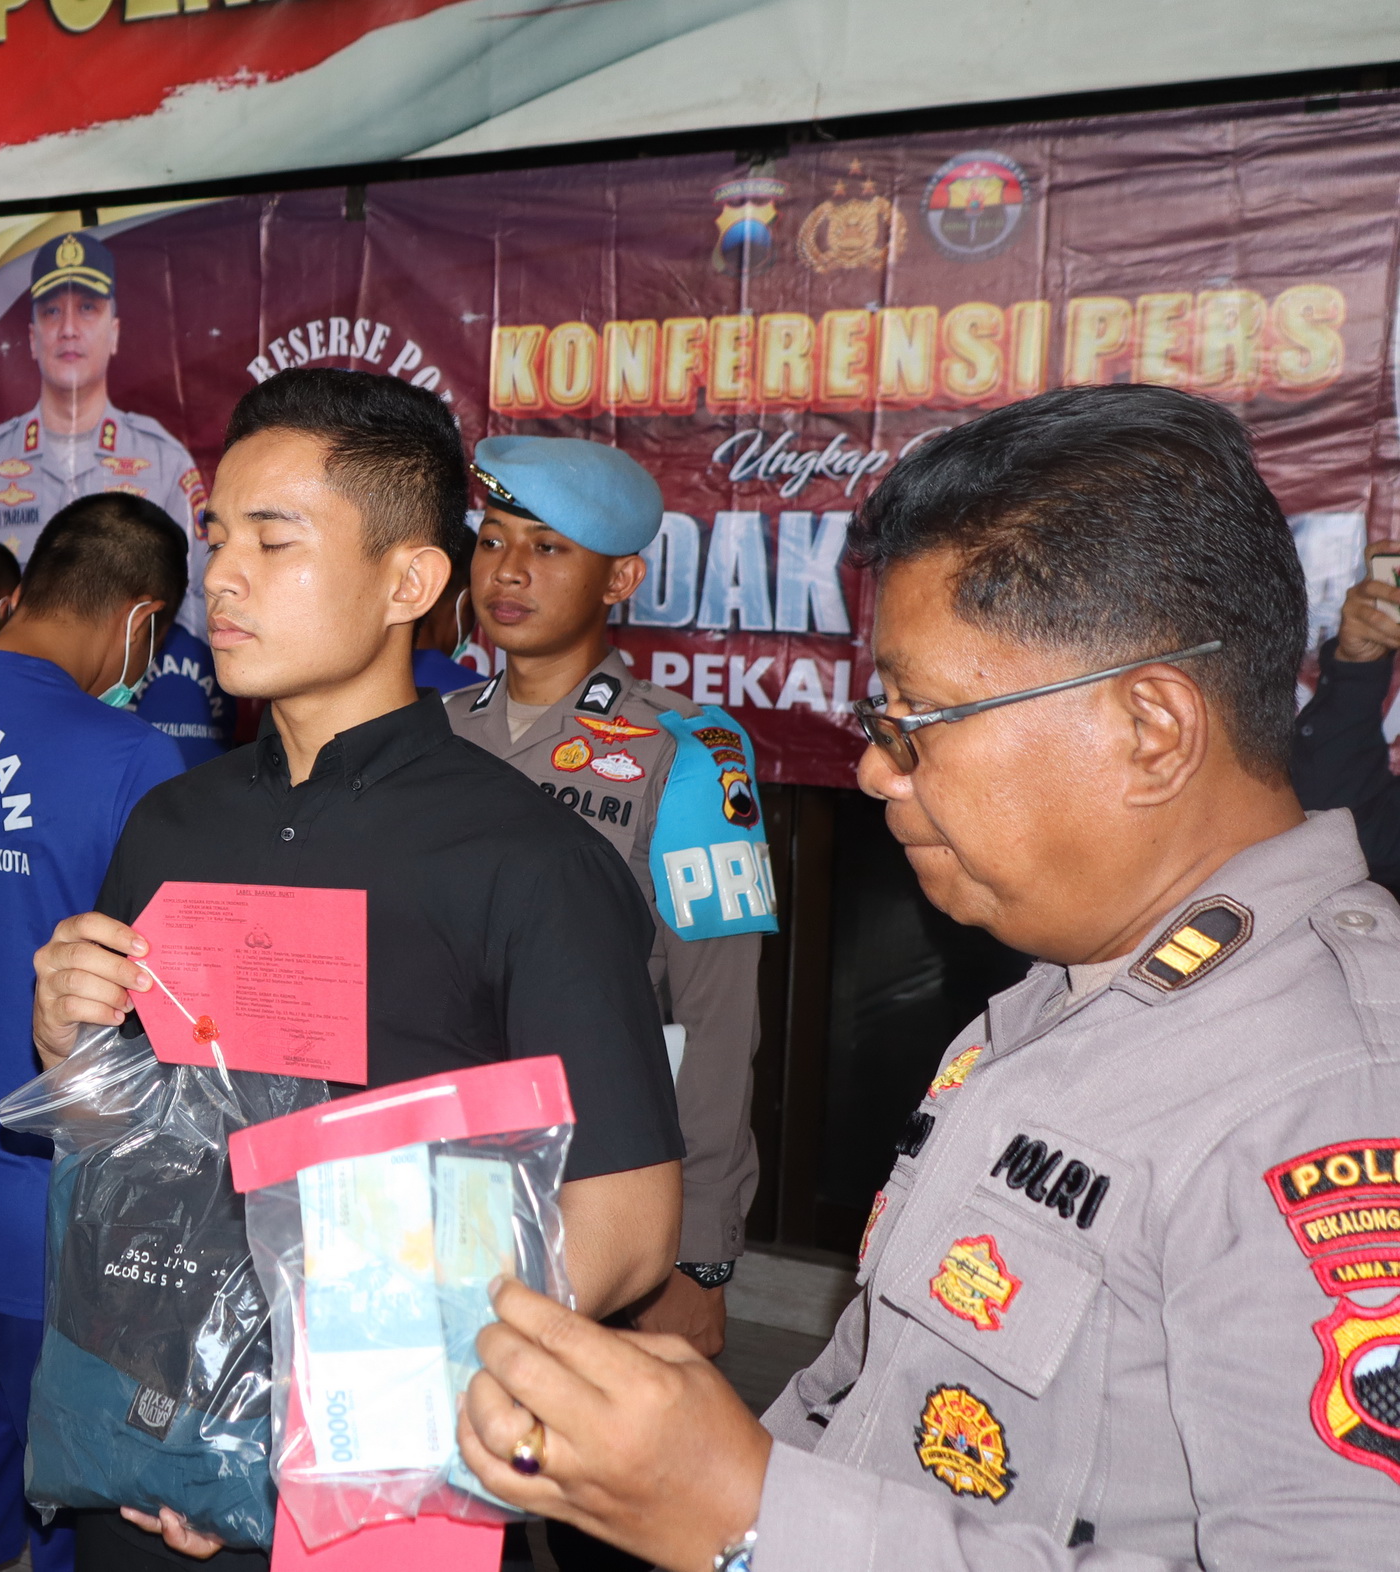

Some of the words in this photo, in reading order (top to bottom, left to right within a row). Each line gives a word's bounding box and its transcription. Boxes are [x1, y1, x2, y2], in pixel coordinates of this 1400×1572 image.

[246, 316, 391, 385] RESERSE
[491, 300, 1050, 410] KONFERENSI
[1064, 284, 1347, 390] PERS
[712, 428, 890, 498] Ungkap
[607, 511, 852, 634] DAK
[989, 1133, 1111, 1230] POLRI
[1291, 1148, 1400, 1197] POL
[325, 1389, 353, 1463] 50000
